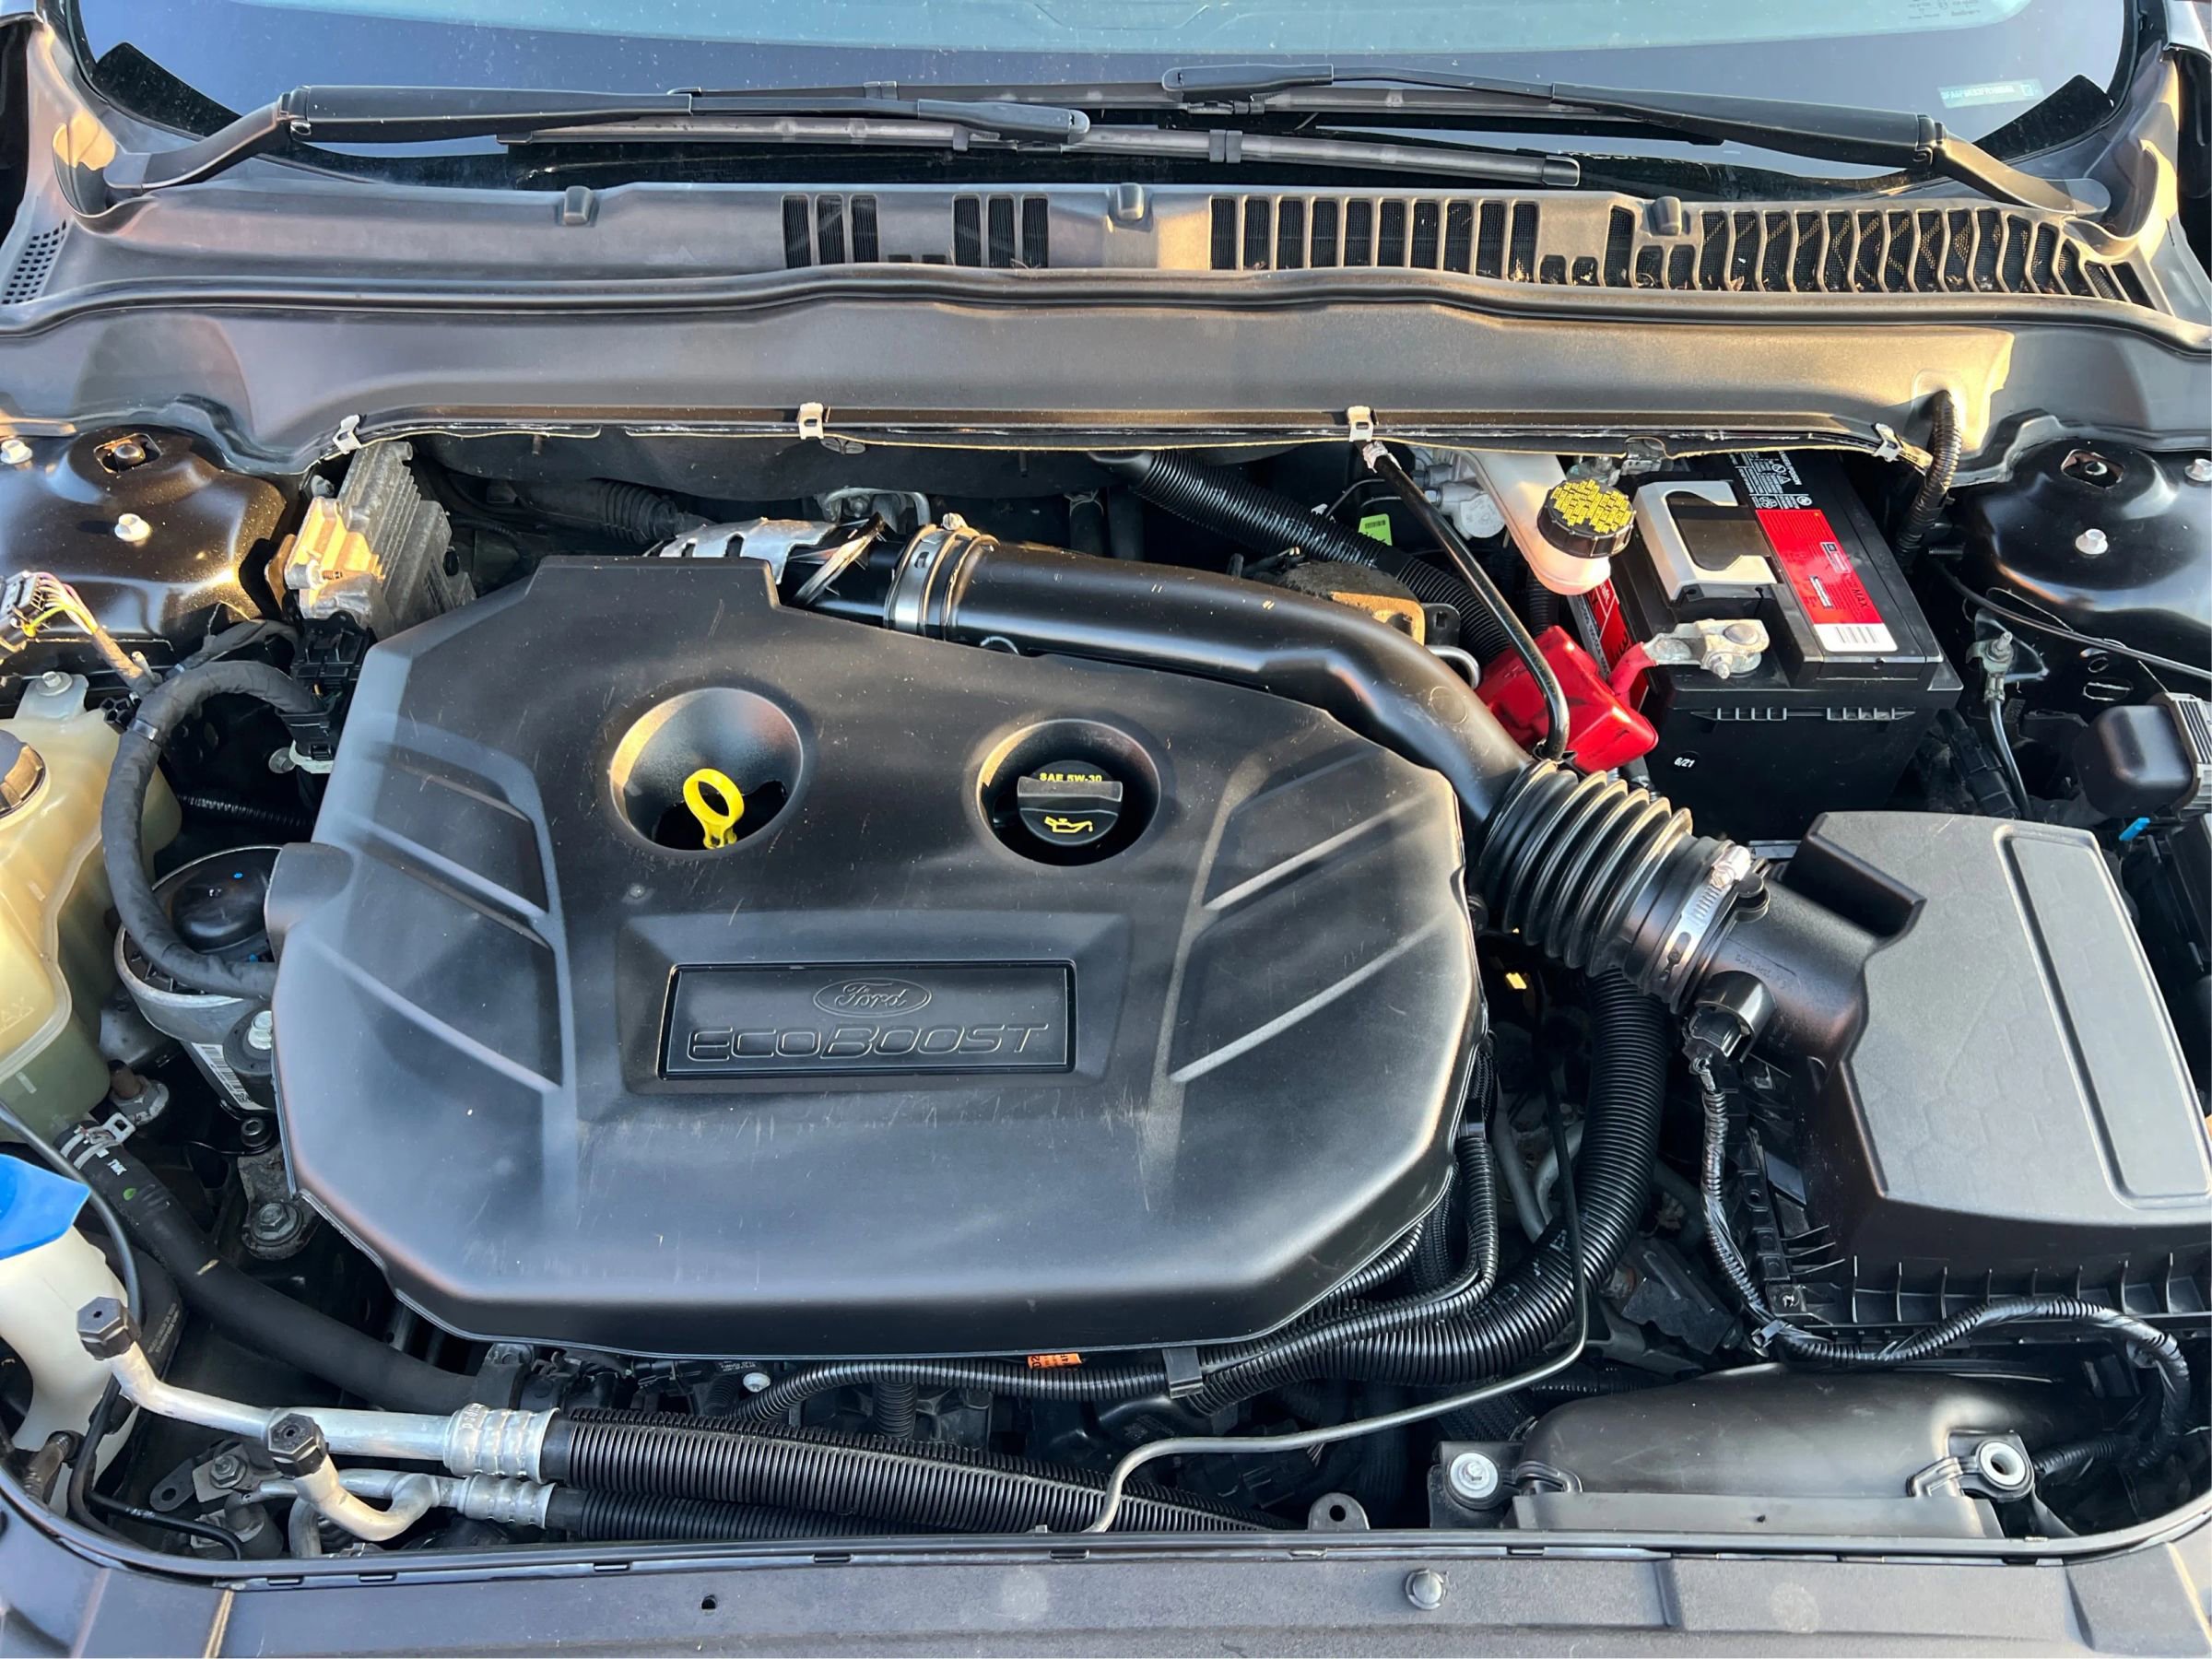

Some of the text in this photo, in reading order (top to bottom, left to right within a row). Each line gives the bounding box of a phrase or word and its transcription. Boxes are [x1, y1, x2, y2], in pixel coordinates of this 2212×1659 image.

[1674, 757, 1695, 768] 6/21
[1039, 772, 1102, 782] SAE 5W-30
[833, 981, 911, 1010] Ford
[687, 1023, 1049, 1062] ECOBOOST
